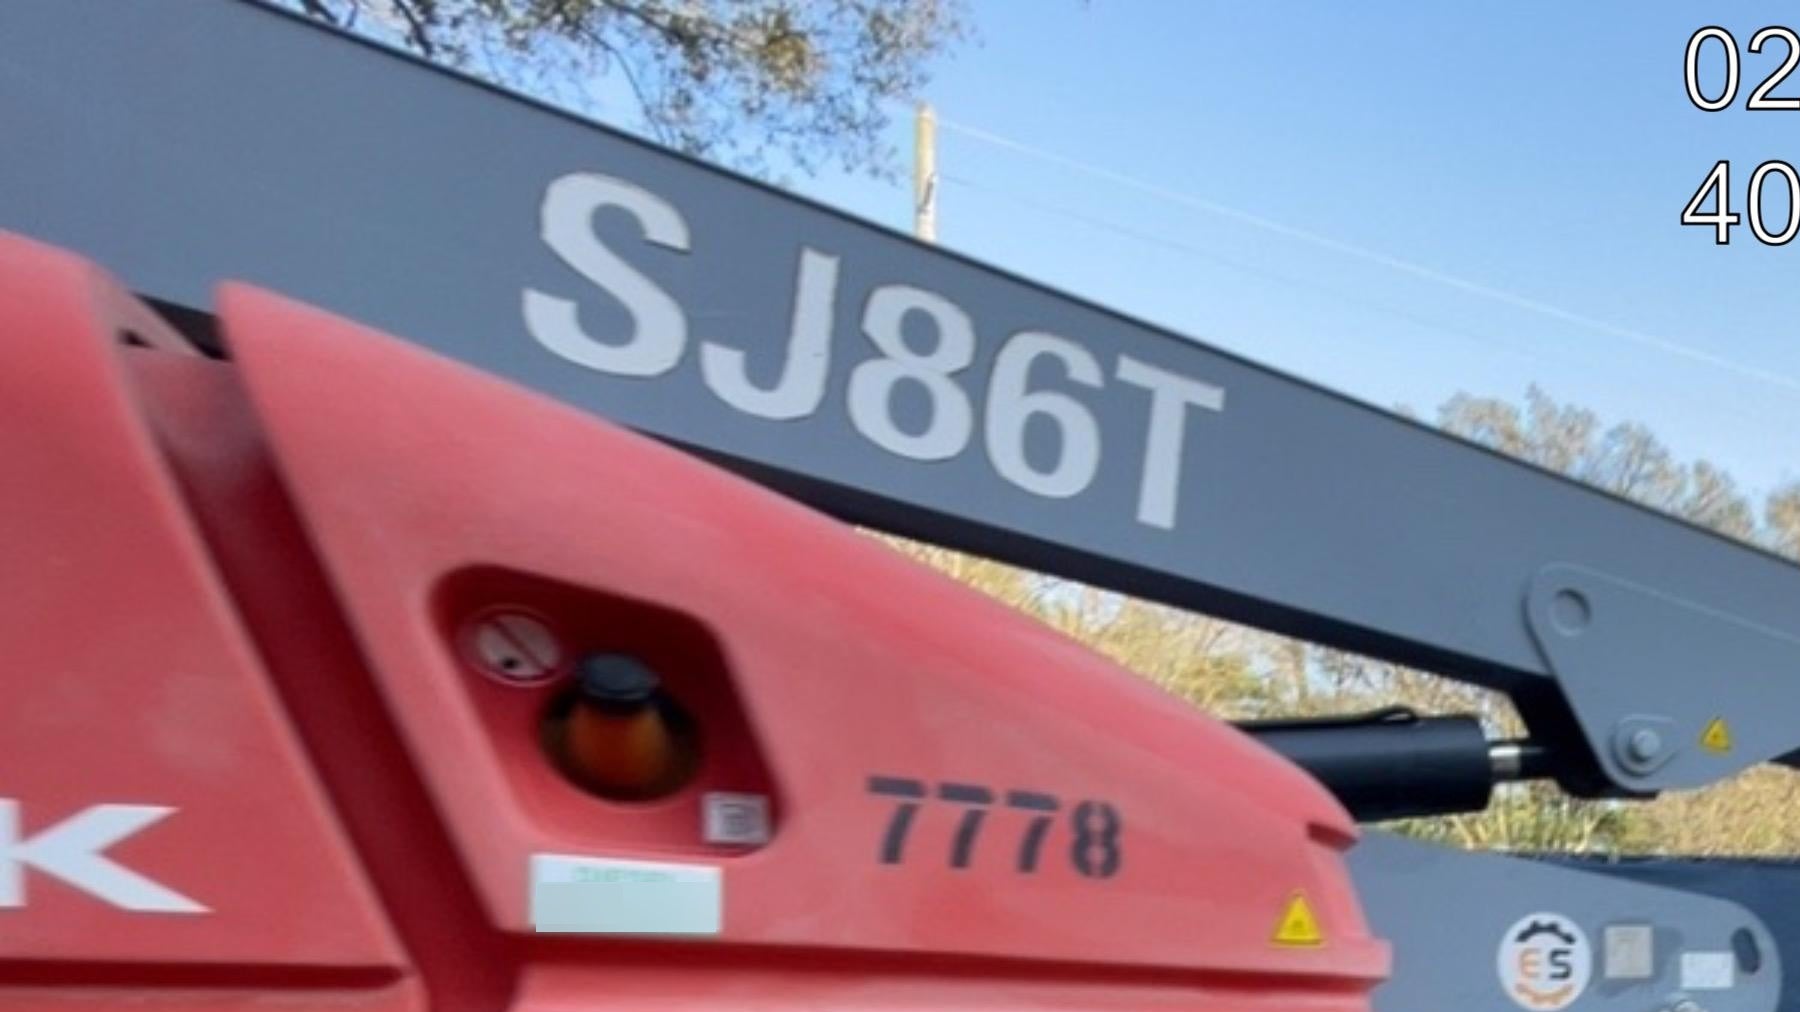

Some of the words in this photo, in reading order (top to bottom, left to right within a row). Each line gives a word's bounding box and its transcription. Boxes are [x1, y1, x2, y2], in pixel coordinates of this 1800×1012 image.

[521, 171, 1226, 531] SJ86T
[0, 797, 216, 914] K
[866, 775, 1122, 880] 7778
[1518, 947, 1573, 981] ES
